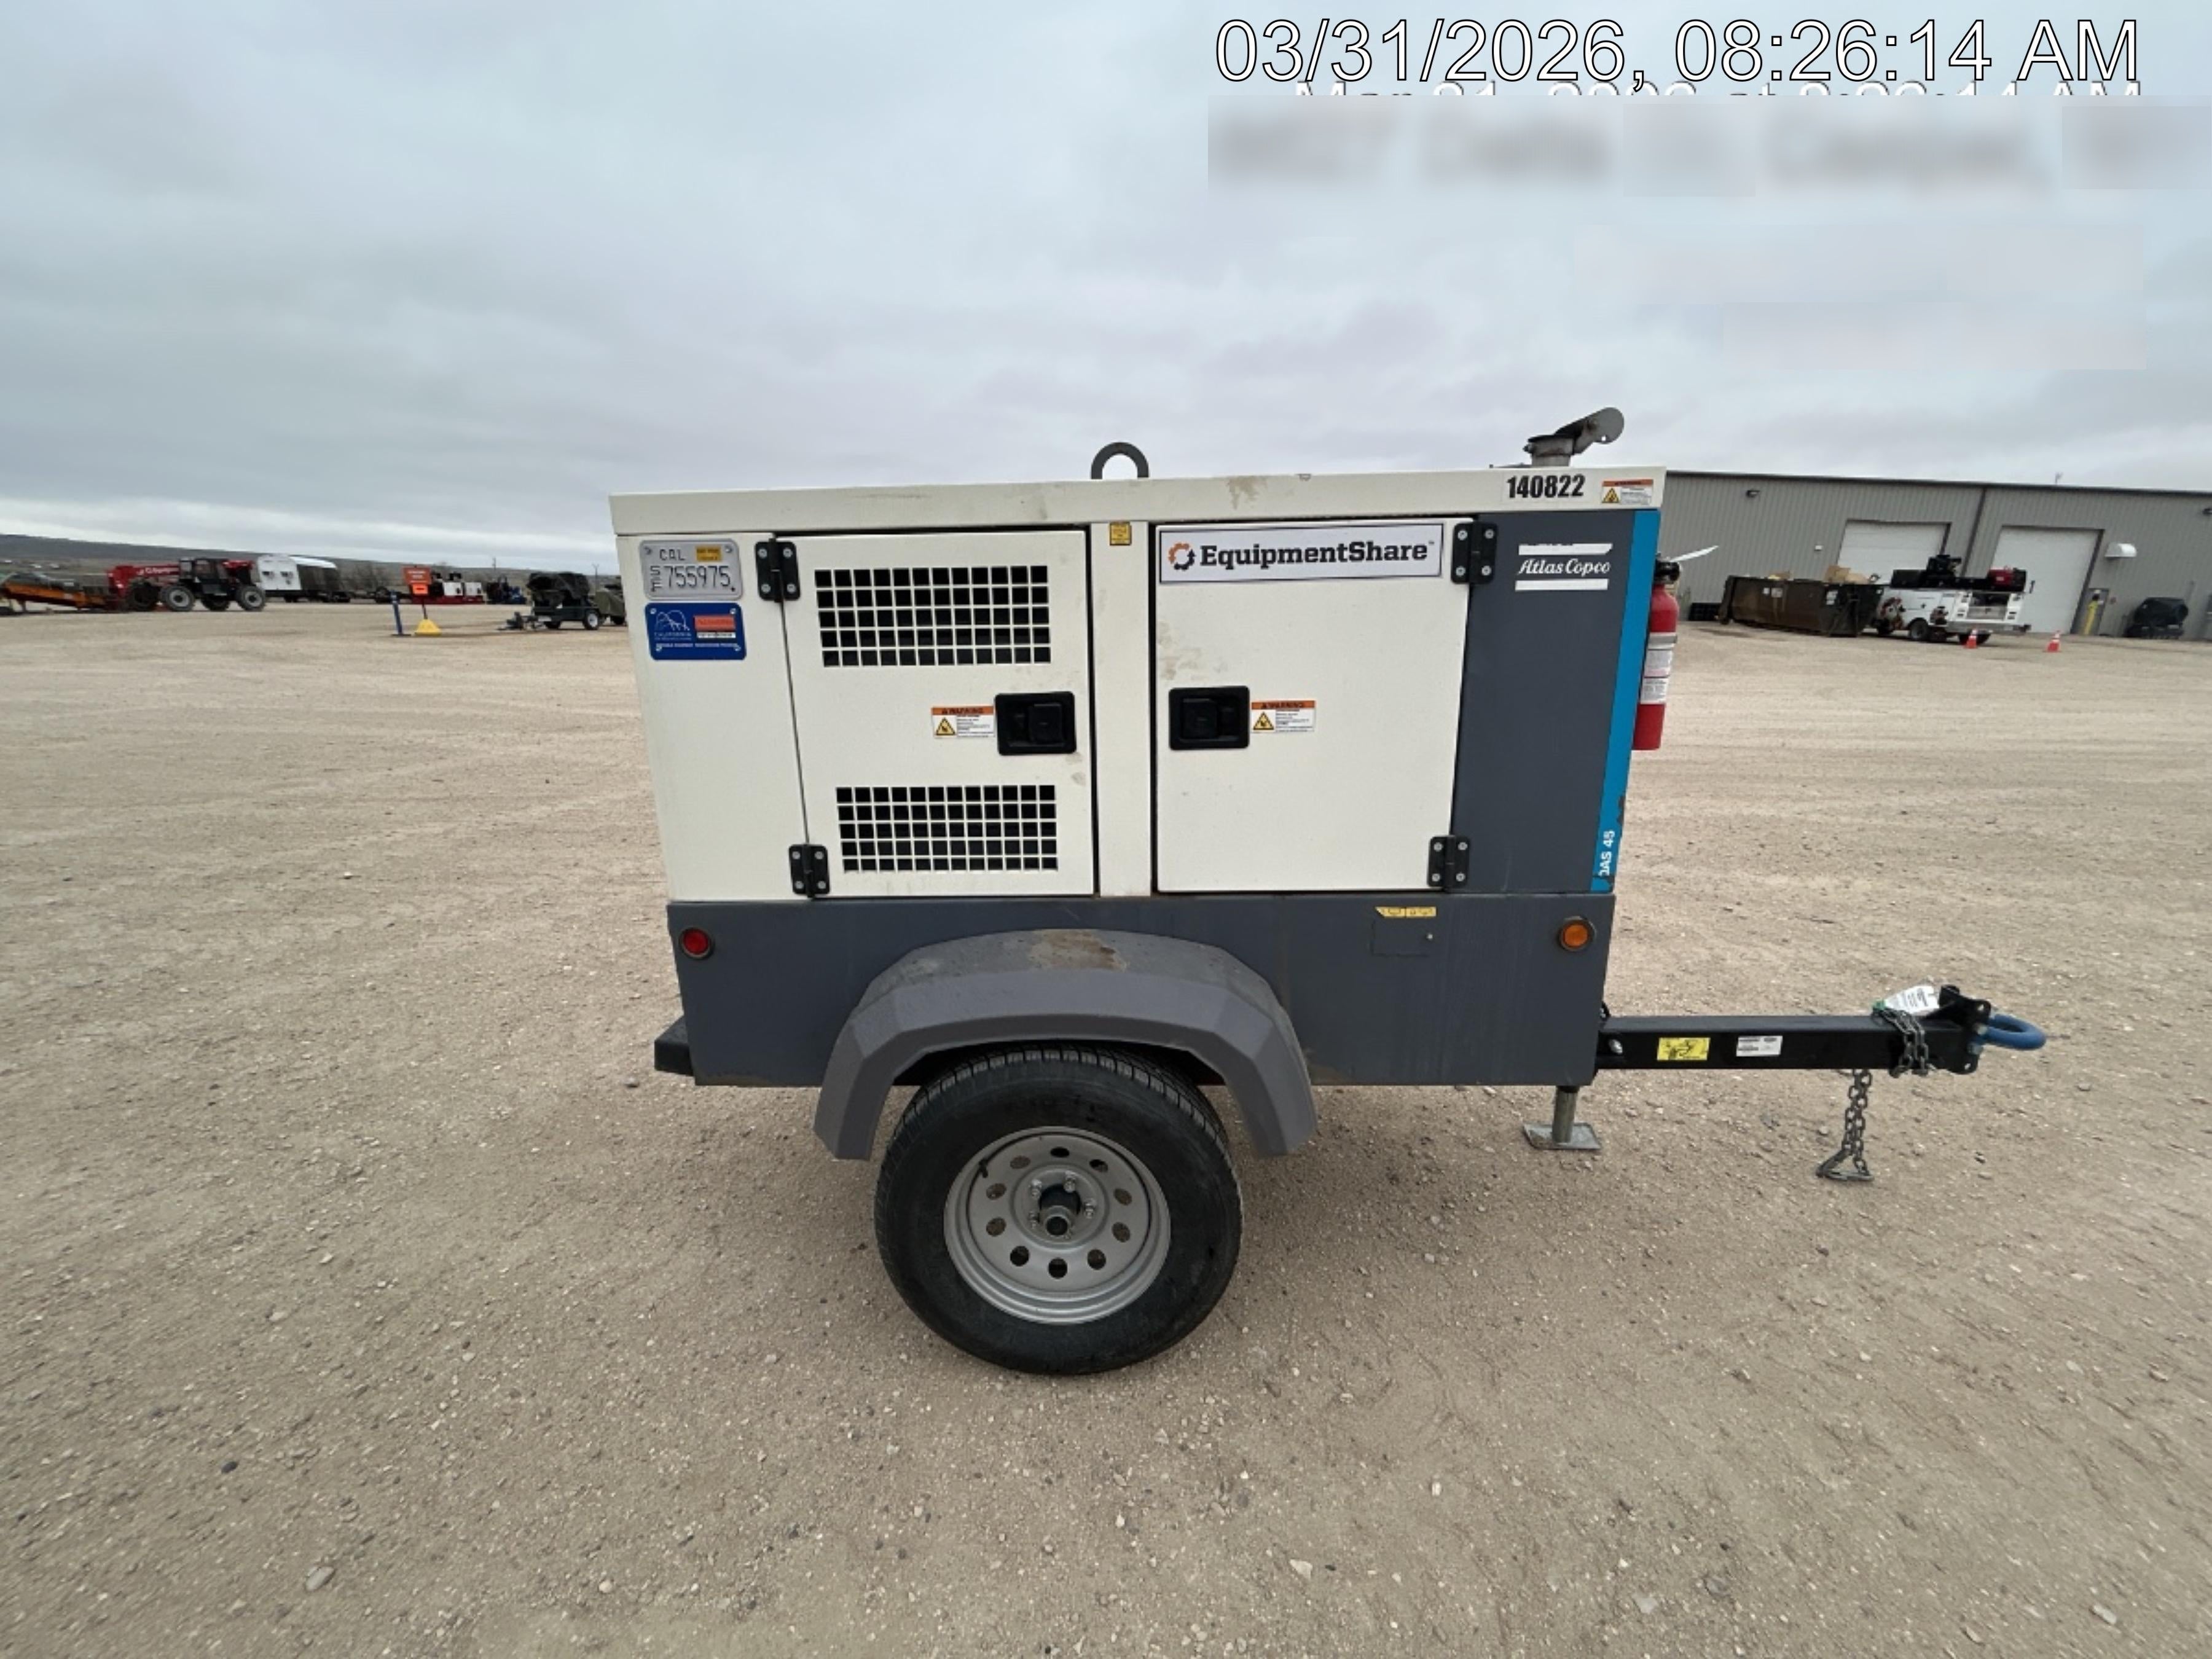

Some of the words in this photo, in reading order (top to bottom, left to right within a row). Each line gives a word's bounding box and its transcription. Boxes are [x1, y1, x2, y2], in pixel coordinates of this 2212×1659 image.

[1508, 474, 1585, 498] 140822
[659, 549, 686, 561] CAL
[1200, 541, 1427, 570] EquipmentShare
[663, 565, 731, 588] 755975
[1517, 559, 1564, 575] Atlas
[1566, 557, 1611, 577] Copco
[1603, 830, 1615, 848] 45
